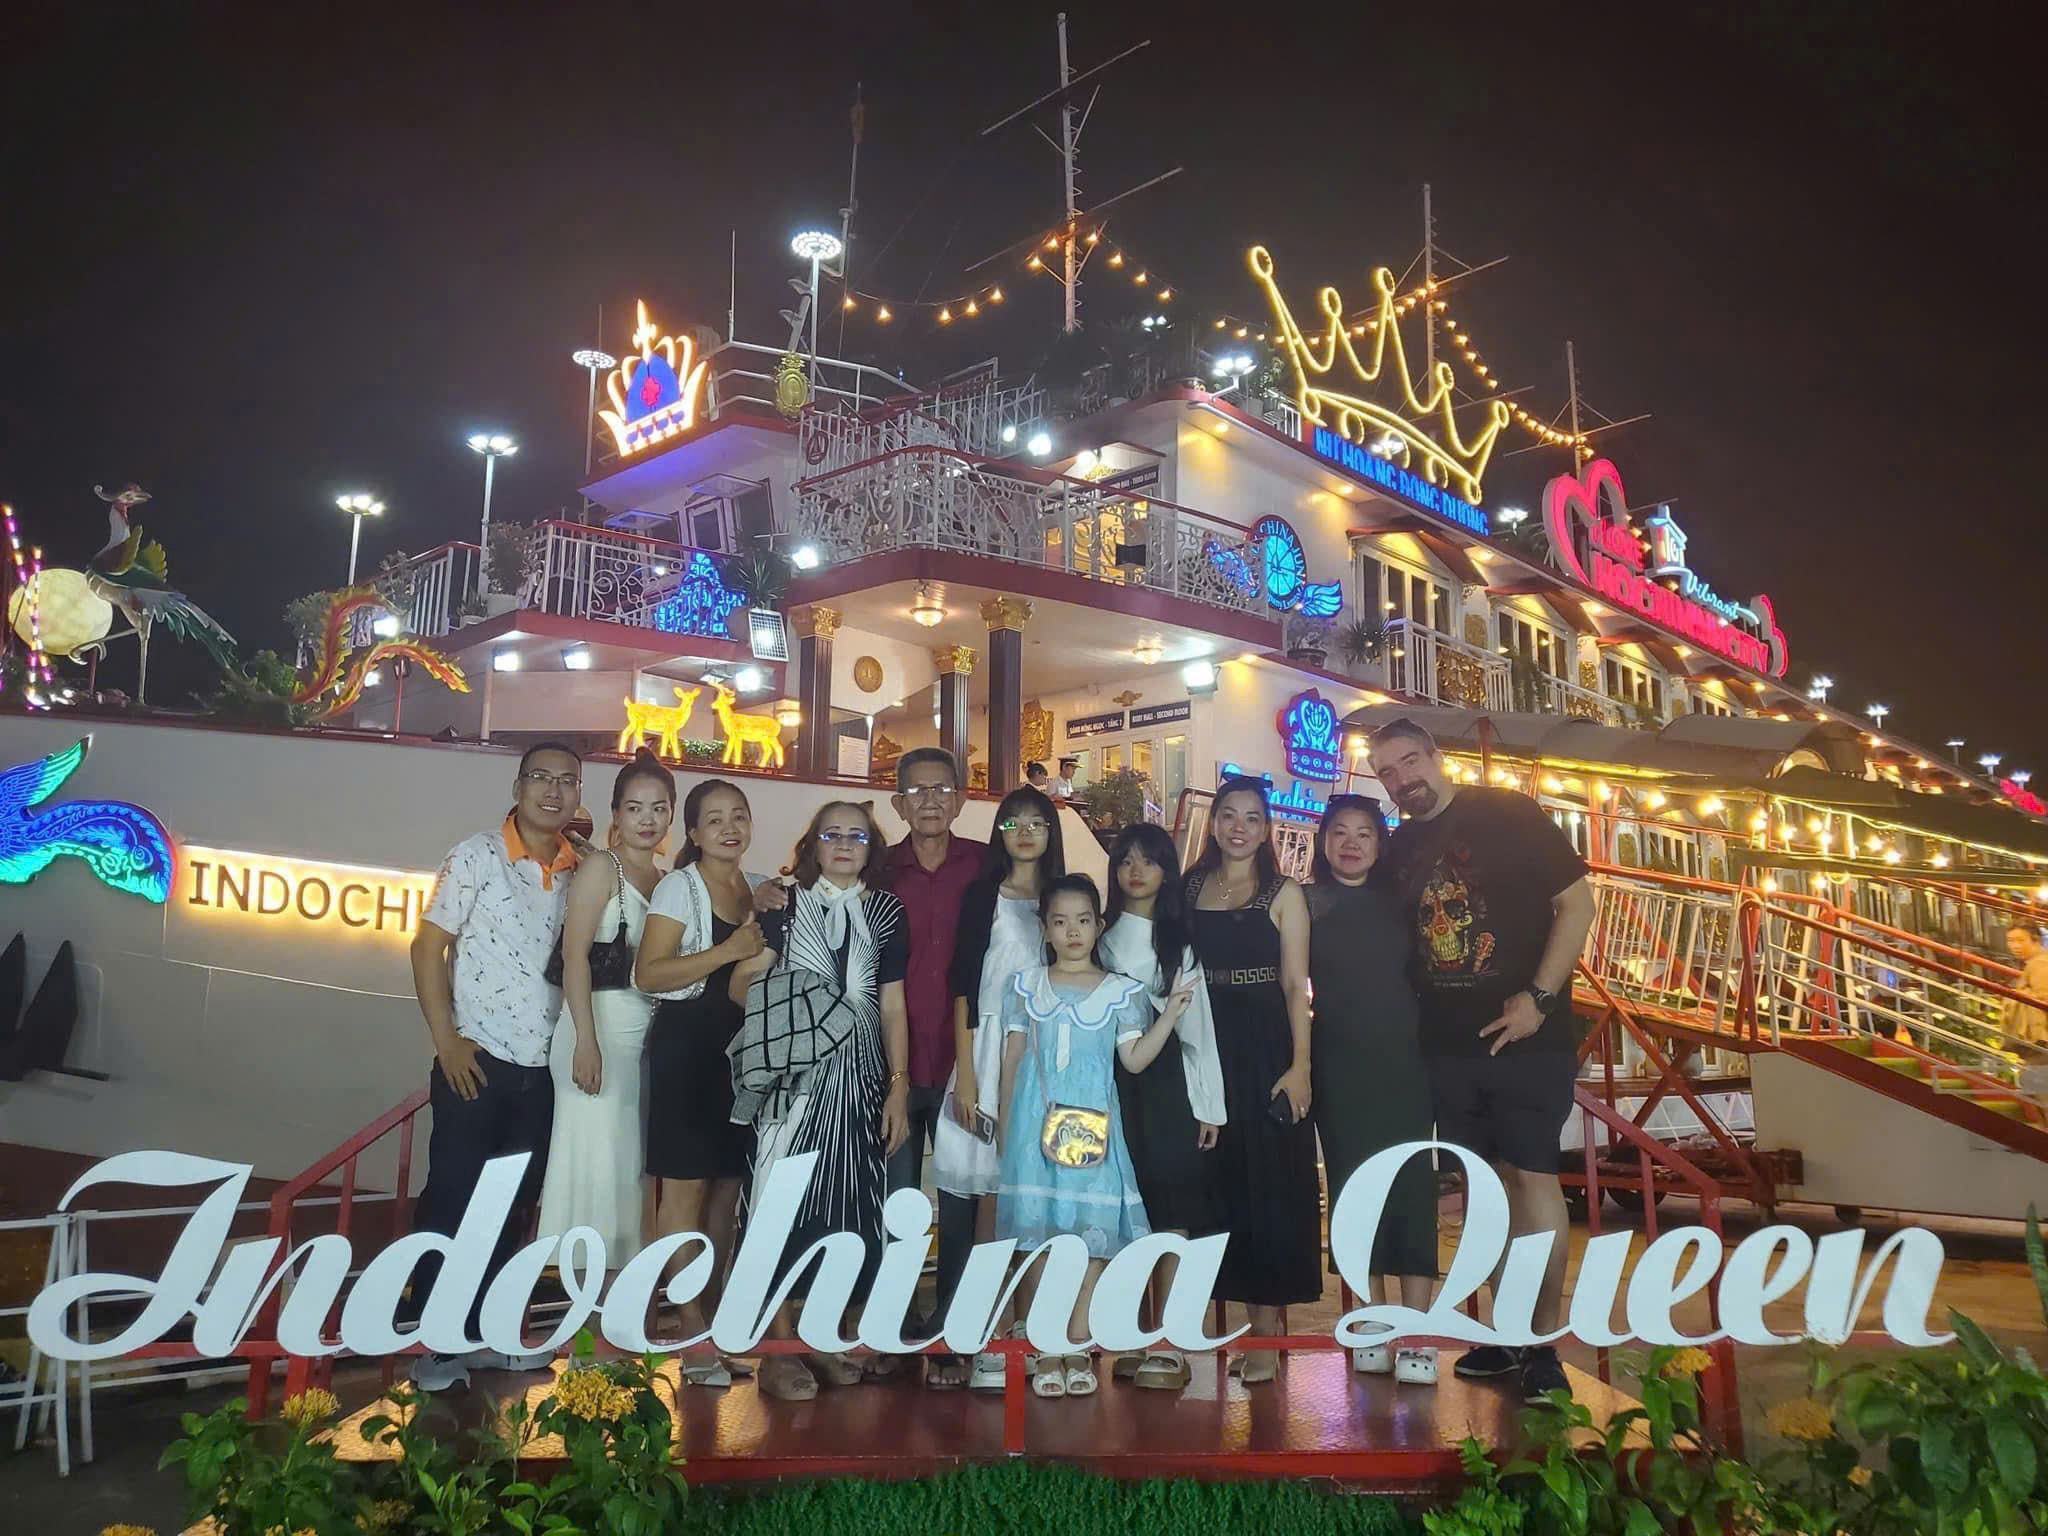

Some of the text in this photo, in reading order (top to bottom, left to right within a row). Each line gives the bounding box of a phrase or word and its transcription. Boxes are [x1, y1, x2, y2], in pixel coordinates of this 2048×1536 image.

[1686, 575, 1739, 619] Vibrant
[26, 1140, 1957, 1361] Indochina Queen
